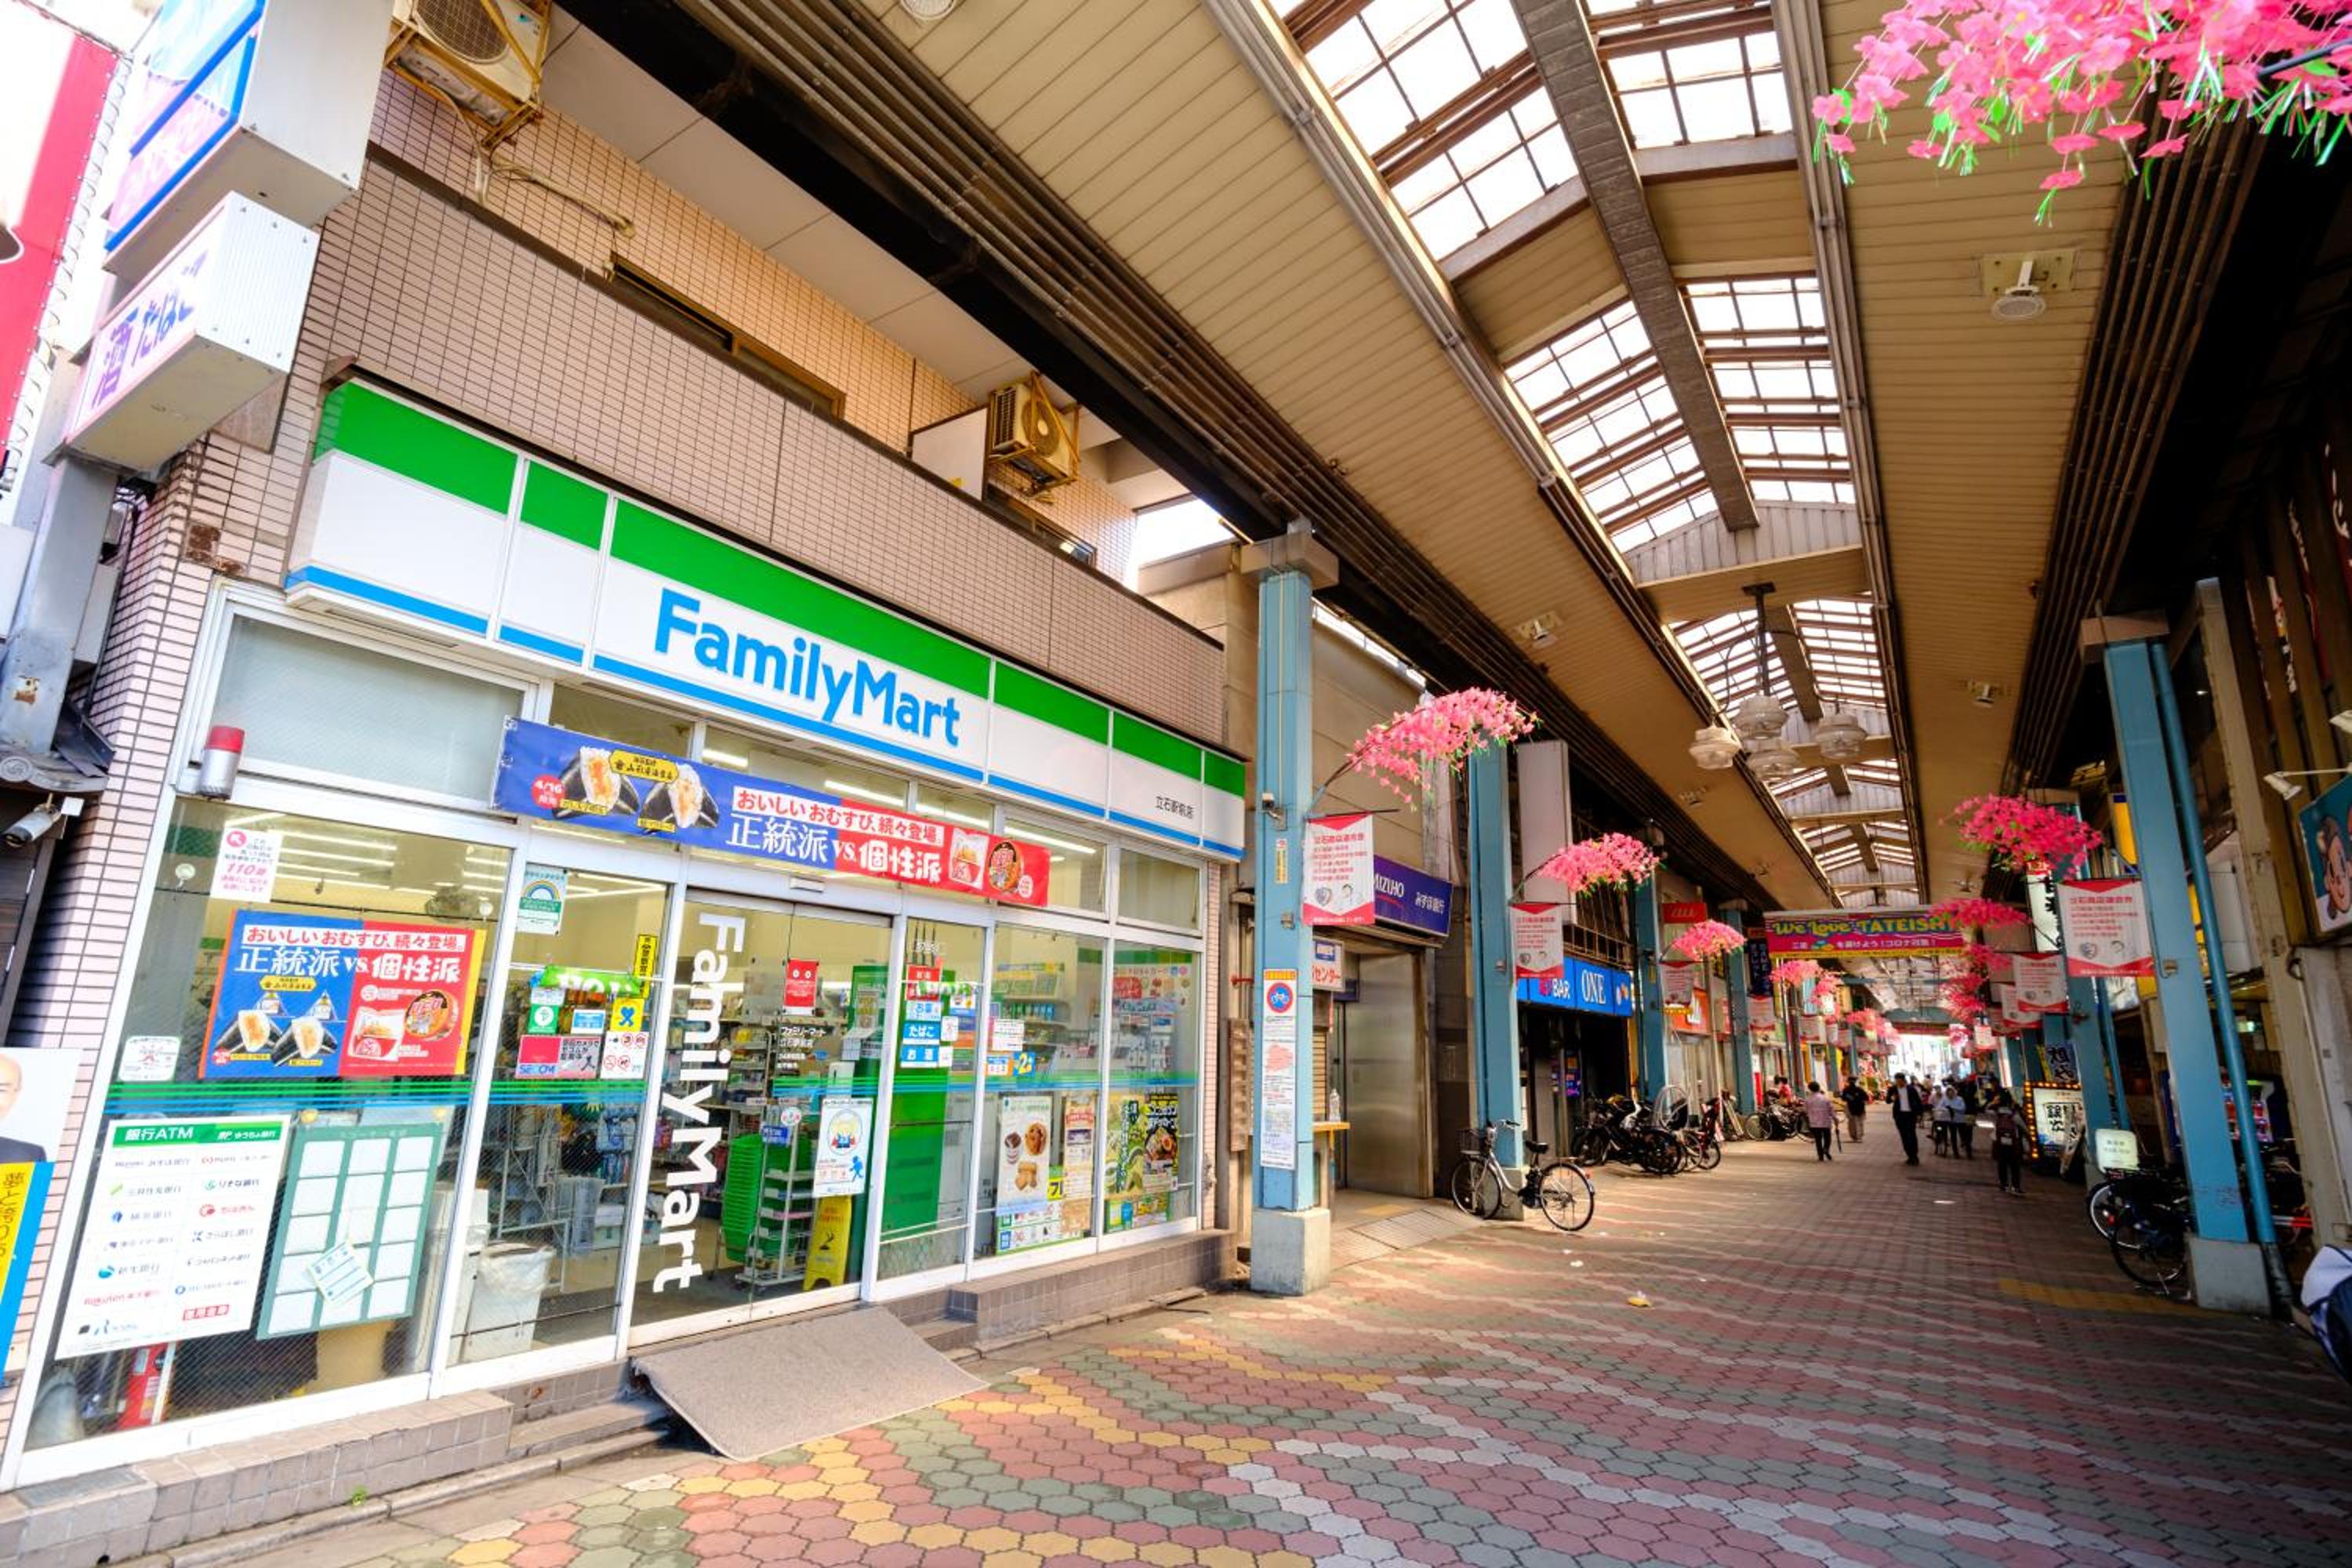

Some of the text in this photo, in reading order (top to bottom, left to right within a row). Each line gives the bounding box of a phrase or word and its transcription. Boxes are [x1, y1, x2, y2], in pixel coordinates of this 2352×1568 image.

[654, 586, 961, 749] FamilyMart
[737, 789, 941, 844] おいしい おむすび、続々登場。
[727, 813, 829, 863] 正統派
[859, 840, 942, 883] 個性派
[1374, 872, 1405, 898] MIZUHO
[1414, 891, 1445, 915] みずほ銀行
[247, 927, 466, 953] おいしい おむすび、続々登場。
[1773, 921, 1805, 935] We
[1806, 920, 1851, 938] Love
[234, 945, 340, 977] 正統派
[372, 953, 461, 983] 個性派
[1552, 968, 1606, 1005] BAR ONE
[909, 1025, 935, 1037] たばこ
[519, 1064, 557, 1075] SECOM
[652, 912, 746, 1294] FamilyMart
[124, 1126, 194, 1142] 銀行ATM
[234, 1129, 276, 1141] ゆうちょ銀行
